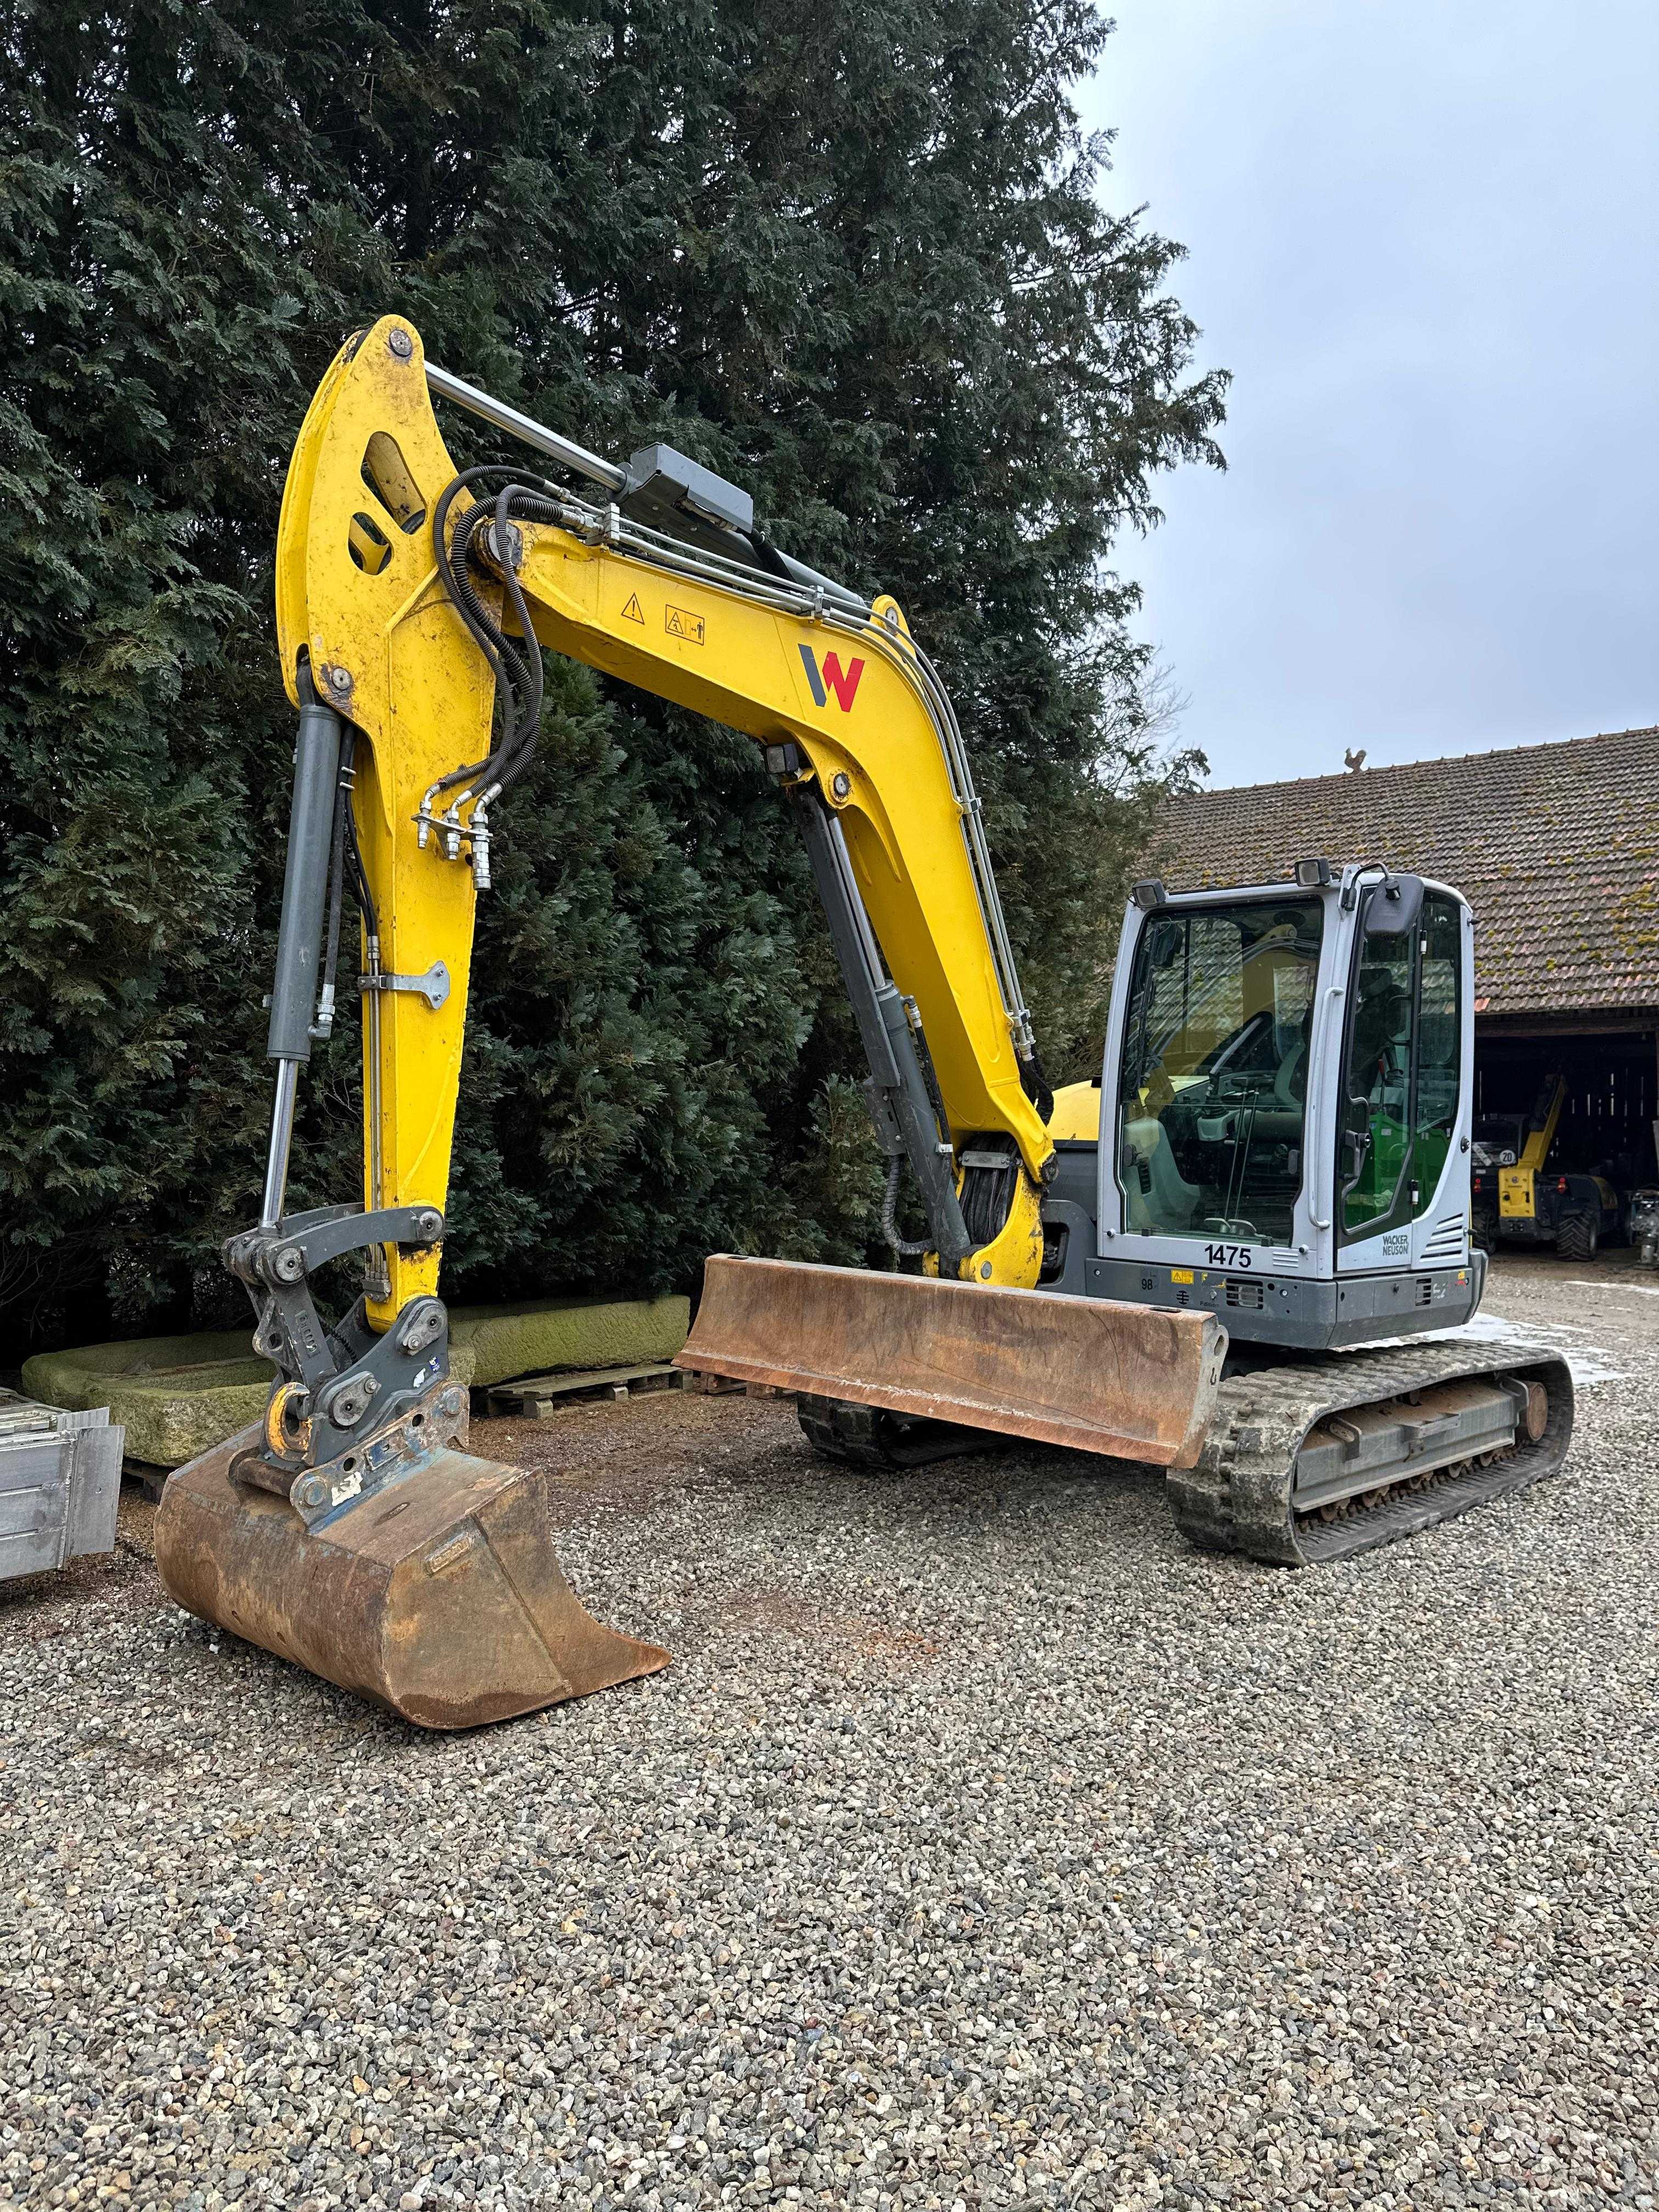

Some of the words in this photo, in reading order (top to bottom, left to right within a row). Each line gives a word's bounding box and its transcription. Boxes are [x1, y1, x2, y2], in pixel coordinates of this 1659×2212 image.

[1503, 1153, 1513, 1162] 20
[1383, 1235, 1408, 1245] WACKER
[1204, 1244, 1251, 1268] 1475
[1383, 1245, 1408, 1256] NEUSON
[1142, 1278, 1153, 1290] 98
